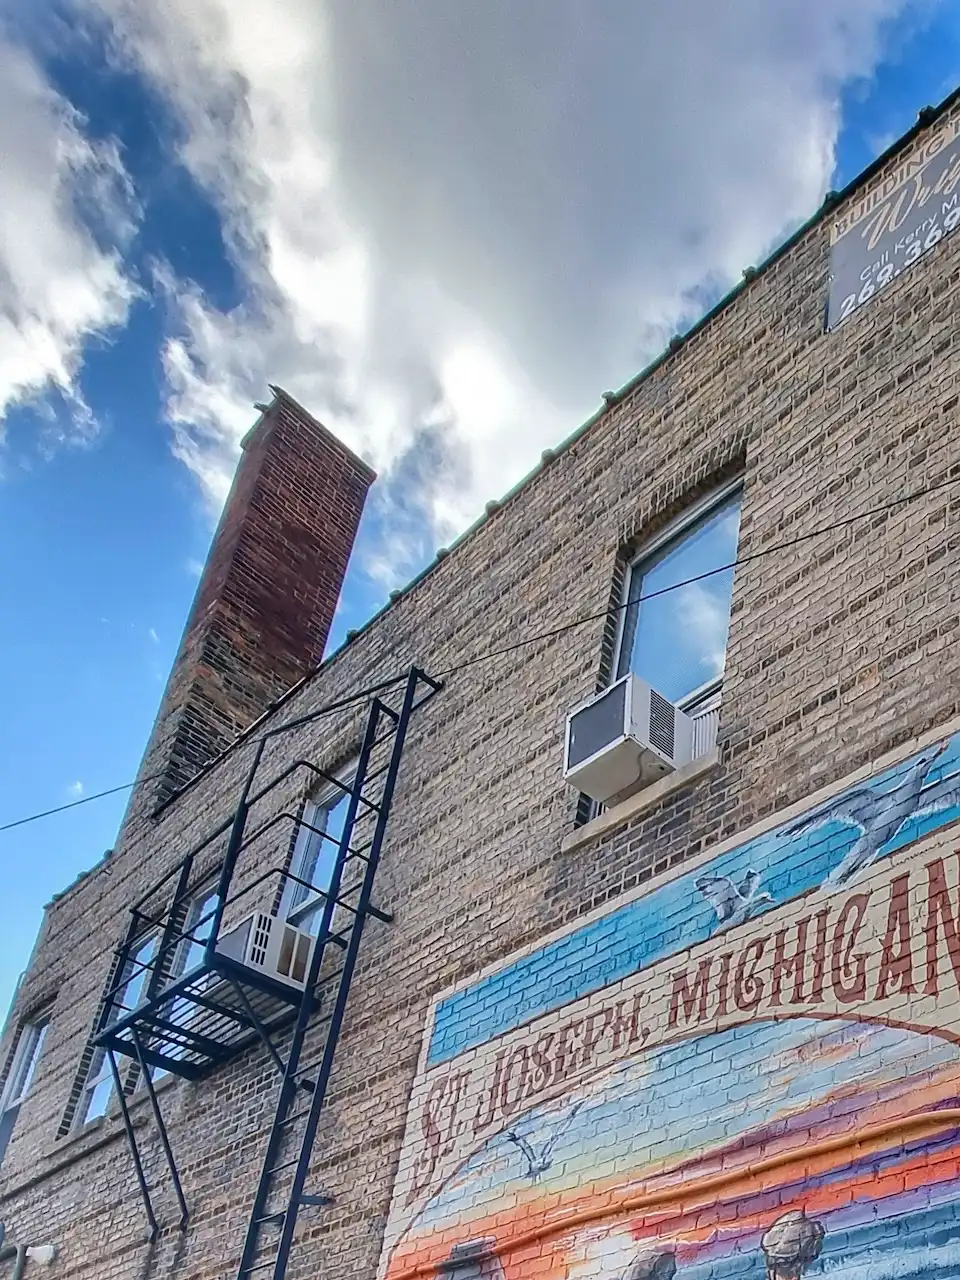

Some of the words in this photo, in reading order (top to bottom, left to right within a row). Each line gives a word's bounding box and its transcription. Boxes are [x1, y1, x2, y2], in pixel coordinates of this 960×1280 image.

[836, 136, 945, 236] BUILDING
[859, 250, 889, 282] Call
[894, 212, 938, 255] Kerry
[472, 989, 651, 1135] JOSEPH,
